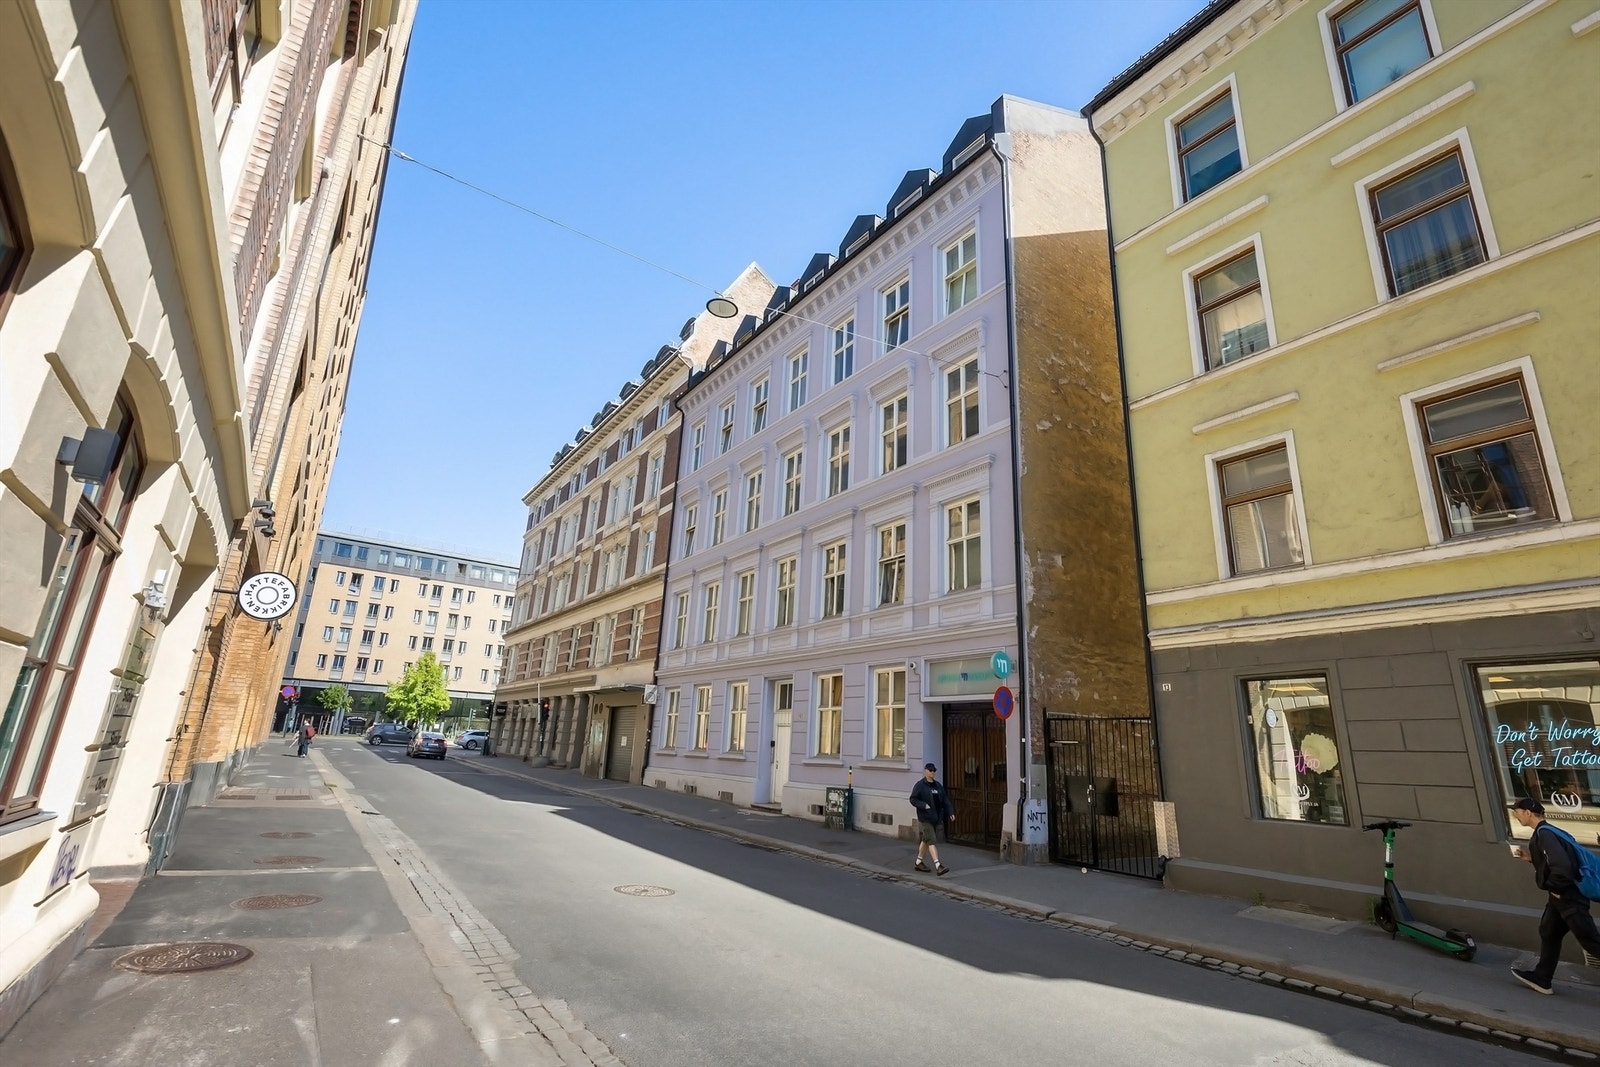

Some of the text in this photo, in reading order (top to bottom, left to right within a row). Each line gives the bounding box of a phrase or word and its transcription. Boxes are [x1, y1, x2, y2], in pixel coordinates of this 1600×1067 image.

[1496, 721, 1539, 744] Don't
[1272, 749, 1320, 775] Tttoo
[1511, 748, 1543, 774] Get
